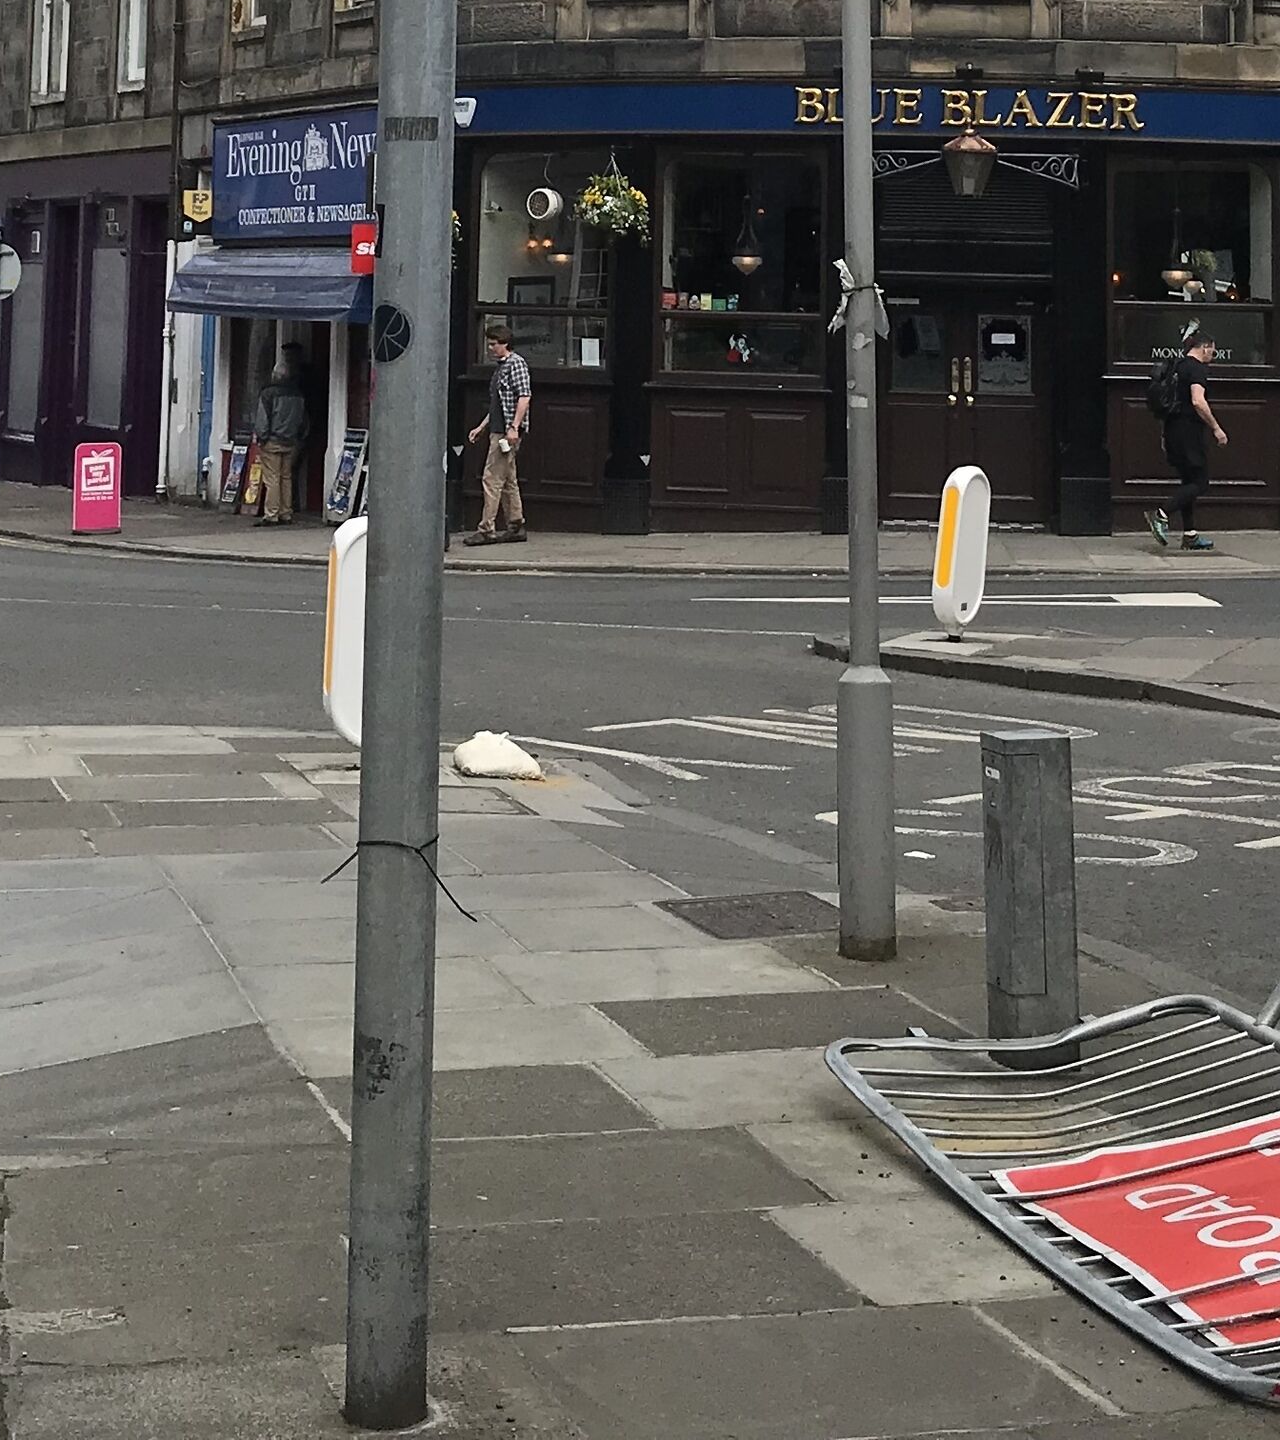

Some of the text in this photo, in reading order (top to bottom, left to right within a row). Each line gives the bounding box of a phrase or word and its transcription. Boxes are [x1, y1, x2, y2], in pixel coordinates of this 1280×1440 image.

[795, 86, 1145, 131] BLUE BLAZER
[226, 121, 377, 186] Evening New
[238, 206, 306, 226] CONFECTIONER
[307, 207, 315, 223] &
